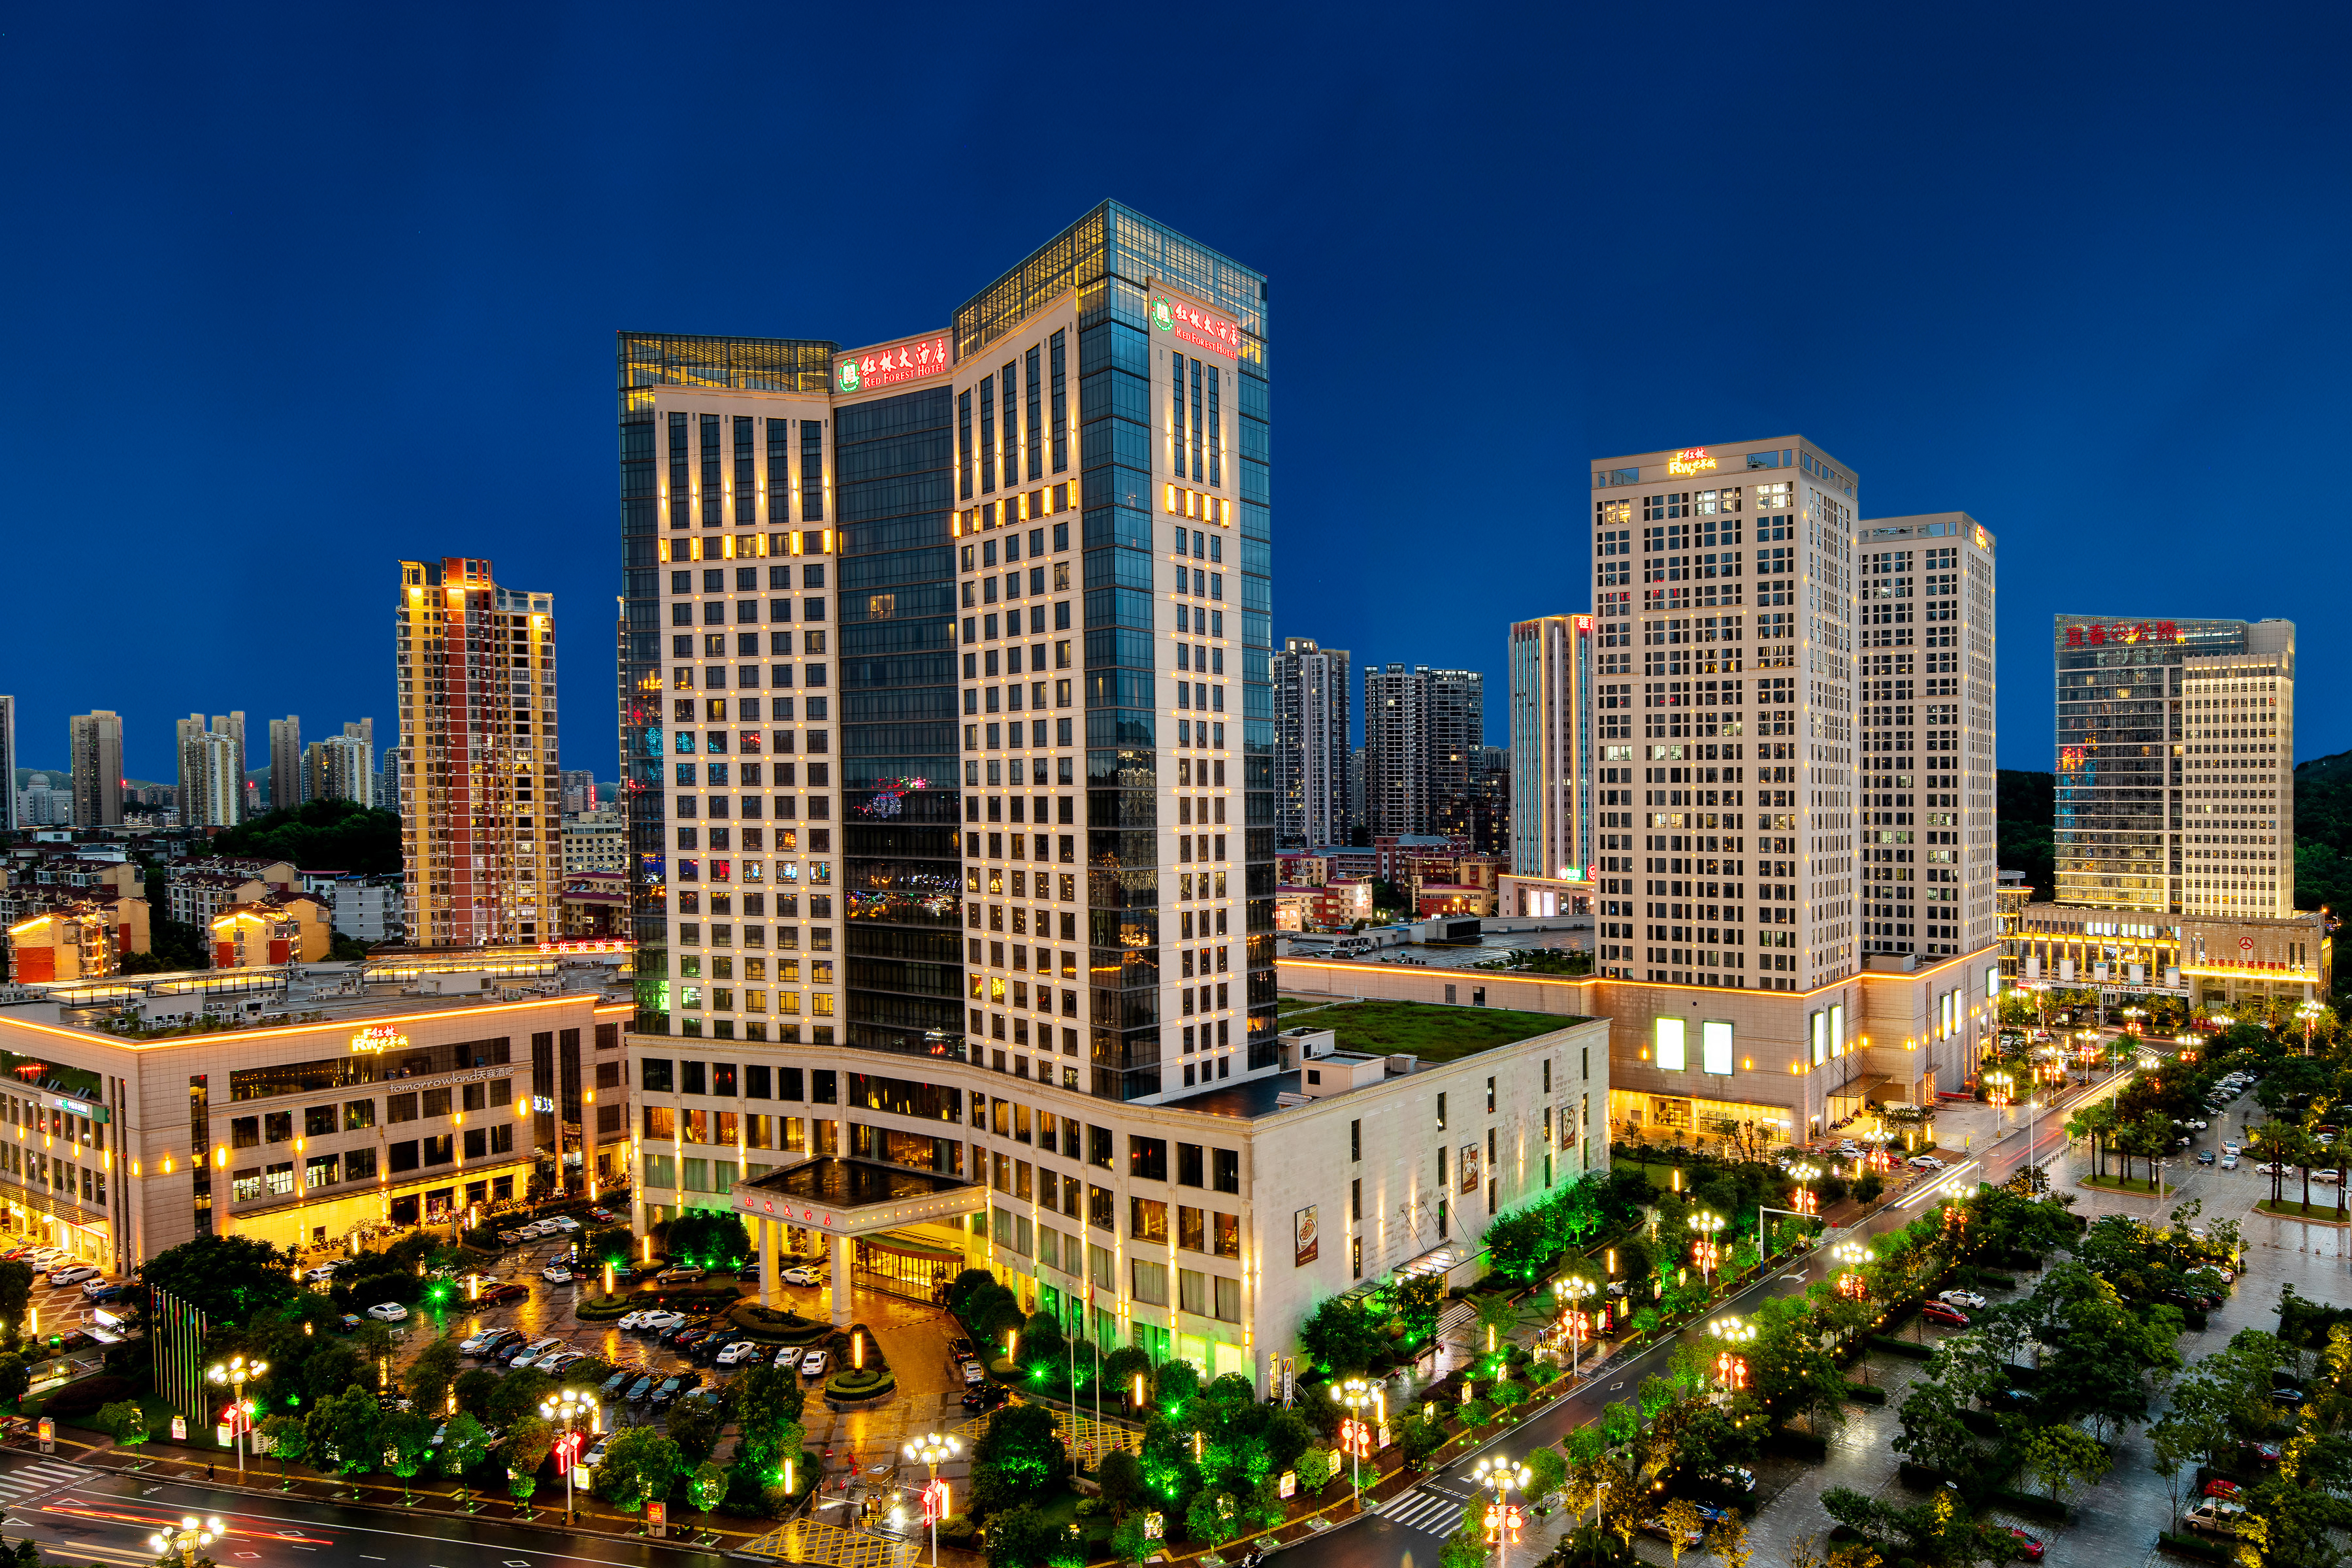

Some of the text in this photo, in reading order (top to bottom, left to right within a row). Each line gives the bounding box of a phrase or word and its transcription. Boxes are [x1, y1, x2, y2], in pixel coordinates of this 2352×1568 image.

[1175, 303, 1238, 346] 红林大酒店
[1175, 326, 1237, 360] RED FOREST HOTEL
[860, 338, 947, 376] 红林大酒店
[864, 363, 946, 387] RED FOREST HOTEL
[1684, 447, 1708, 461] 红林
[1691, 457, 1716, 469] 世界城
[1578, 617, 1593, 630] 桂
[2208, 958, 2286, 971] 宜春市公路管理局
[371, 1025, 399, 1038] 红林
[378, 1035, 408, 1047] 世界城
[389, 1069, 478, 1092] tomorrowland
[744, 1196, 831, 1226] 红林大酒店
